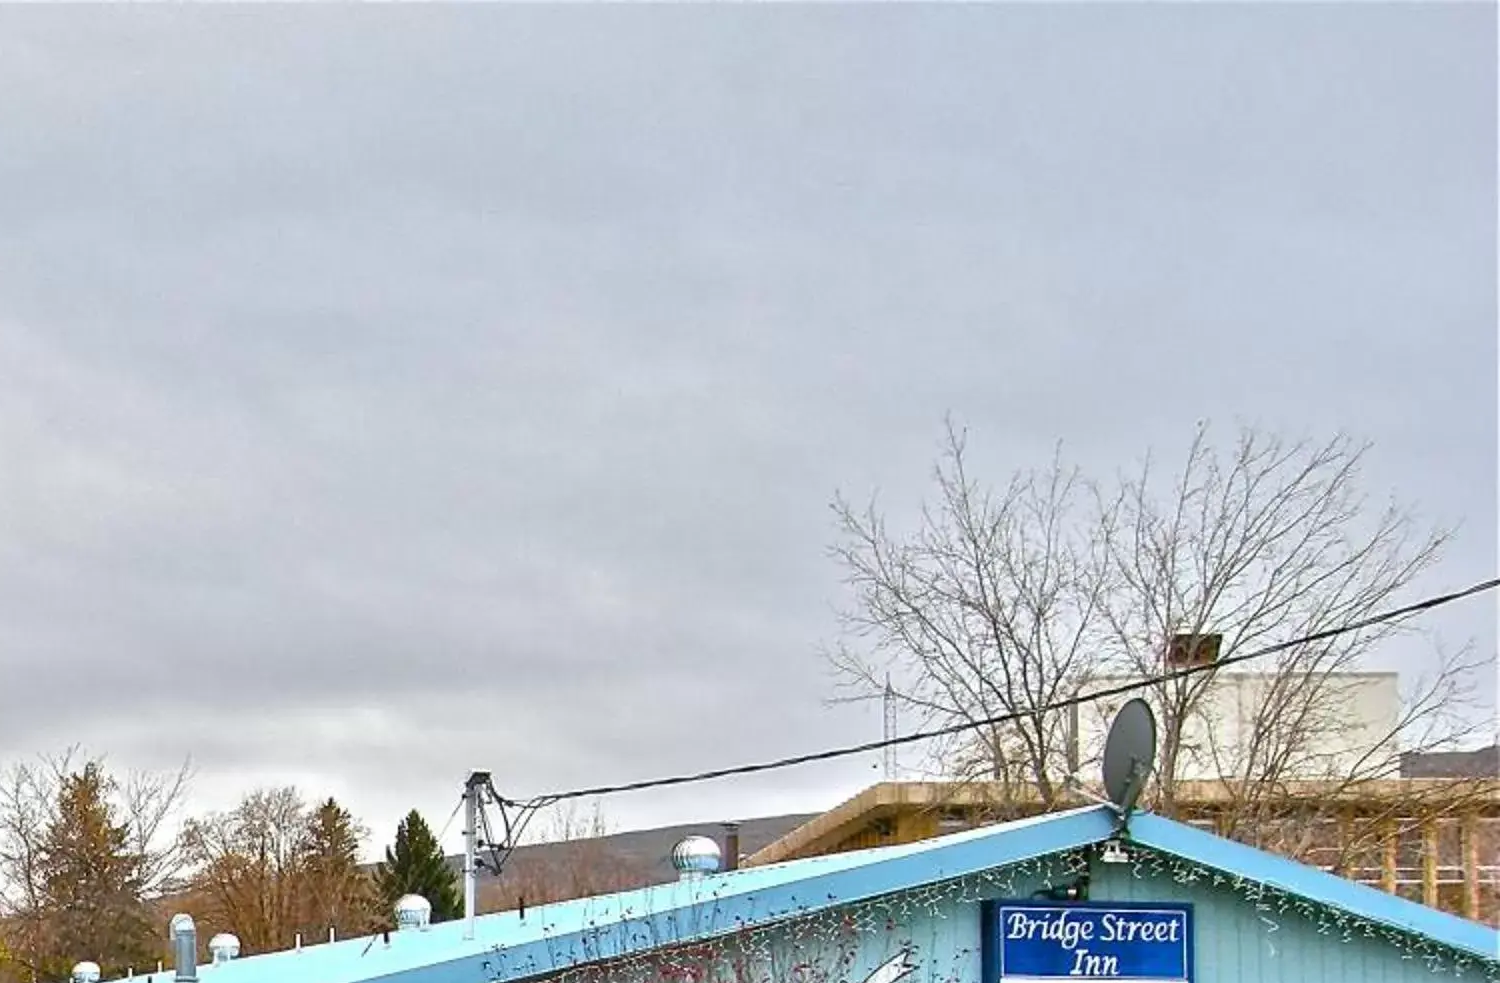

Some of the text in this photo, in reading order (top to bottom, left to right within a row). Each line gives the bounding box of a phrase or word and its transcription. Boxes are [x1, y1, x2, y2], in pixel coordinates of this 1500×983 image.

[1007, 912, 1179, 949] Bridge Street
[1070, 949, 1119, 976] Inn
